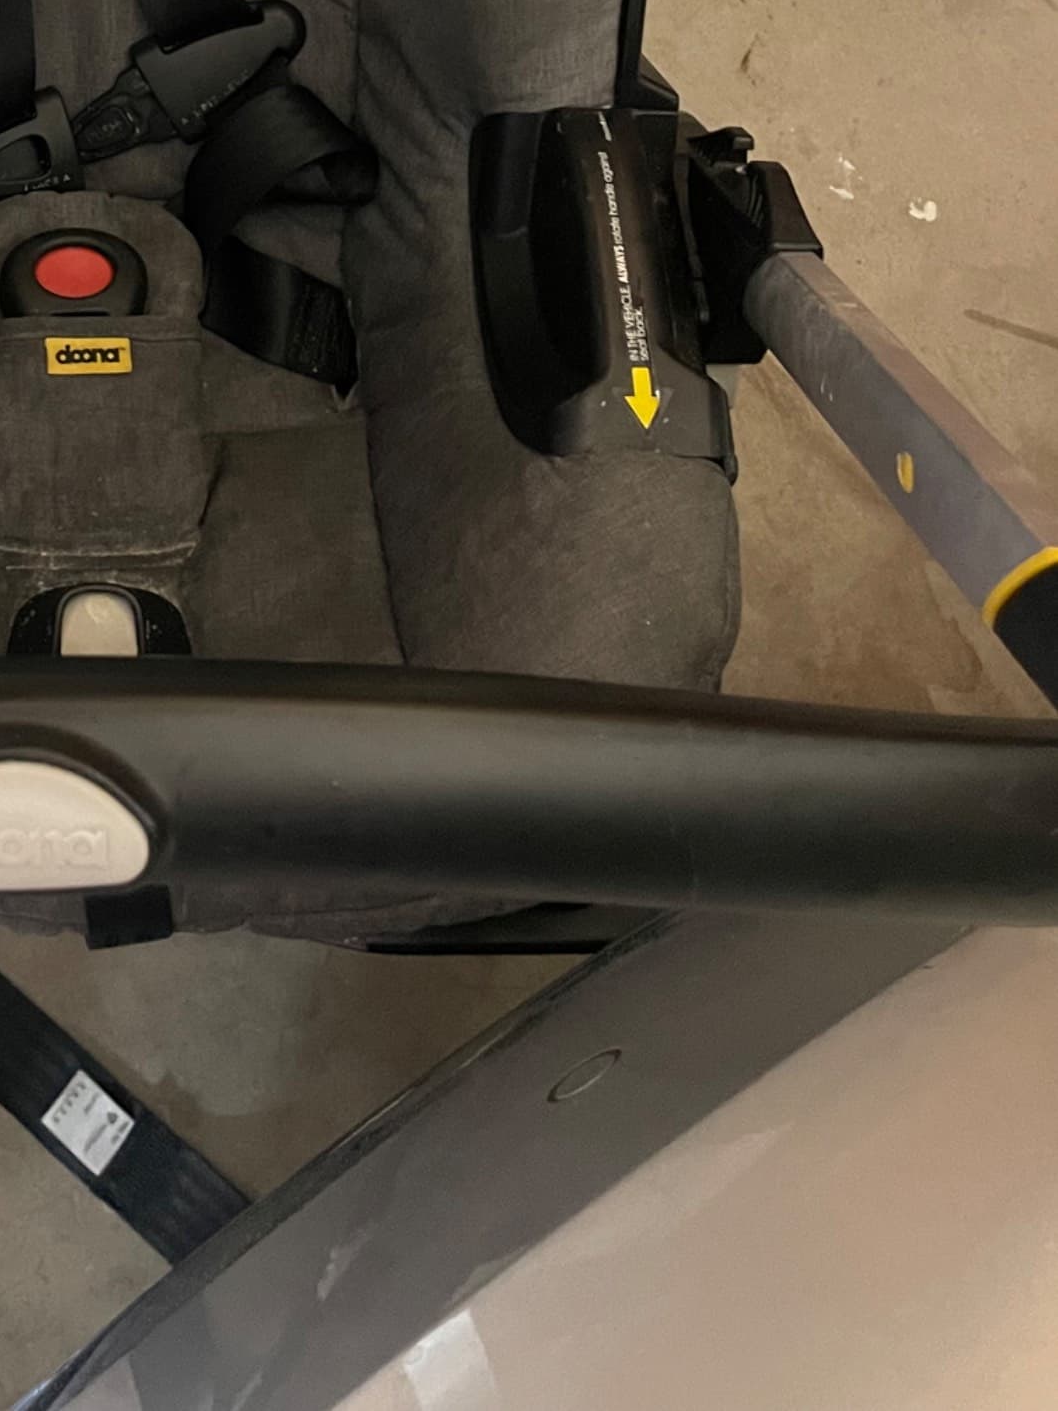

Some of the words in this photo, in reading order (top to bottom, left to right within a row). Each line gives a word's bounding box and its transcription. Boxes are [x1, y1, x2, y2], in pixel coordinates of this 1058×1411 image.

[610, 216, 624, 245] rotate
[613, 245, 629, 283] ALWAYS
[623, 330, 638, 347] THE
[56, 344, 120, 364] doona
[626, 349, 640, 361] IN
[638, 338, 650, 362] seat
